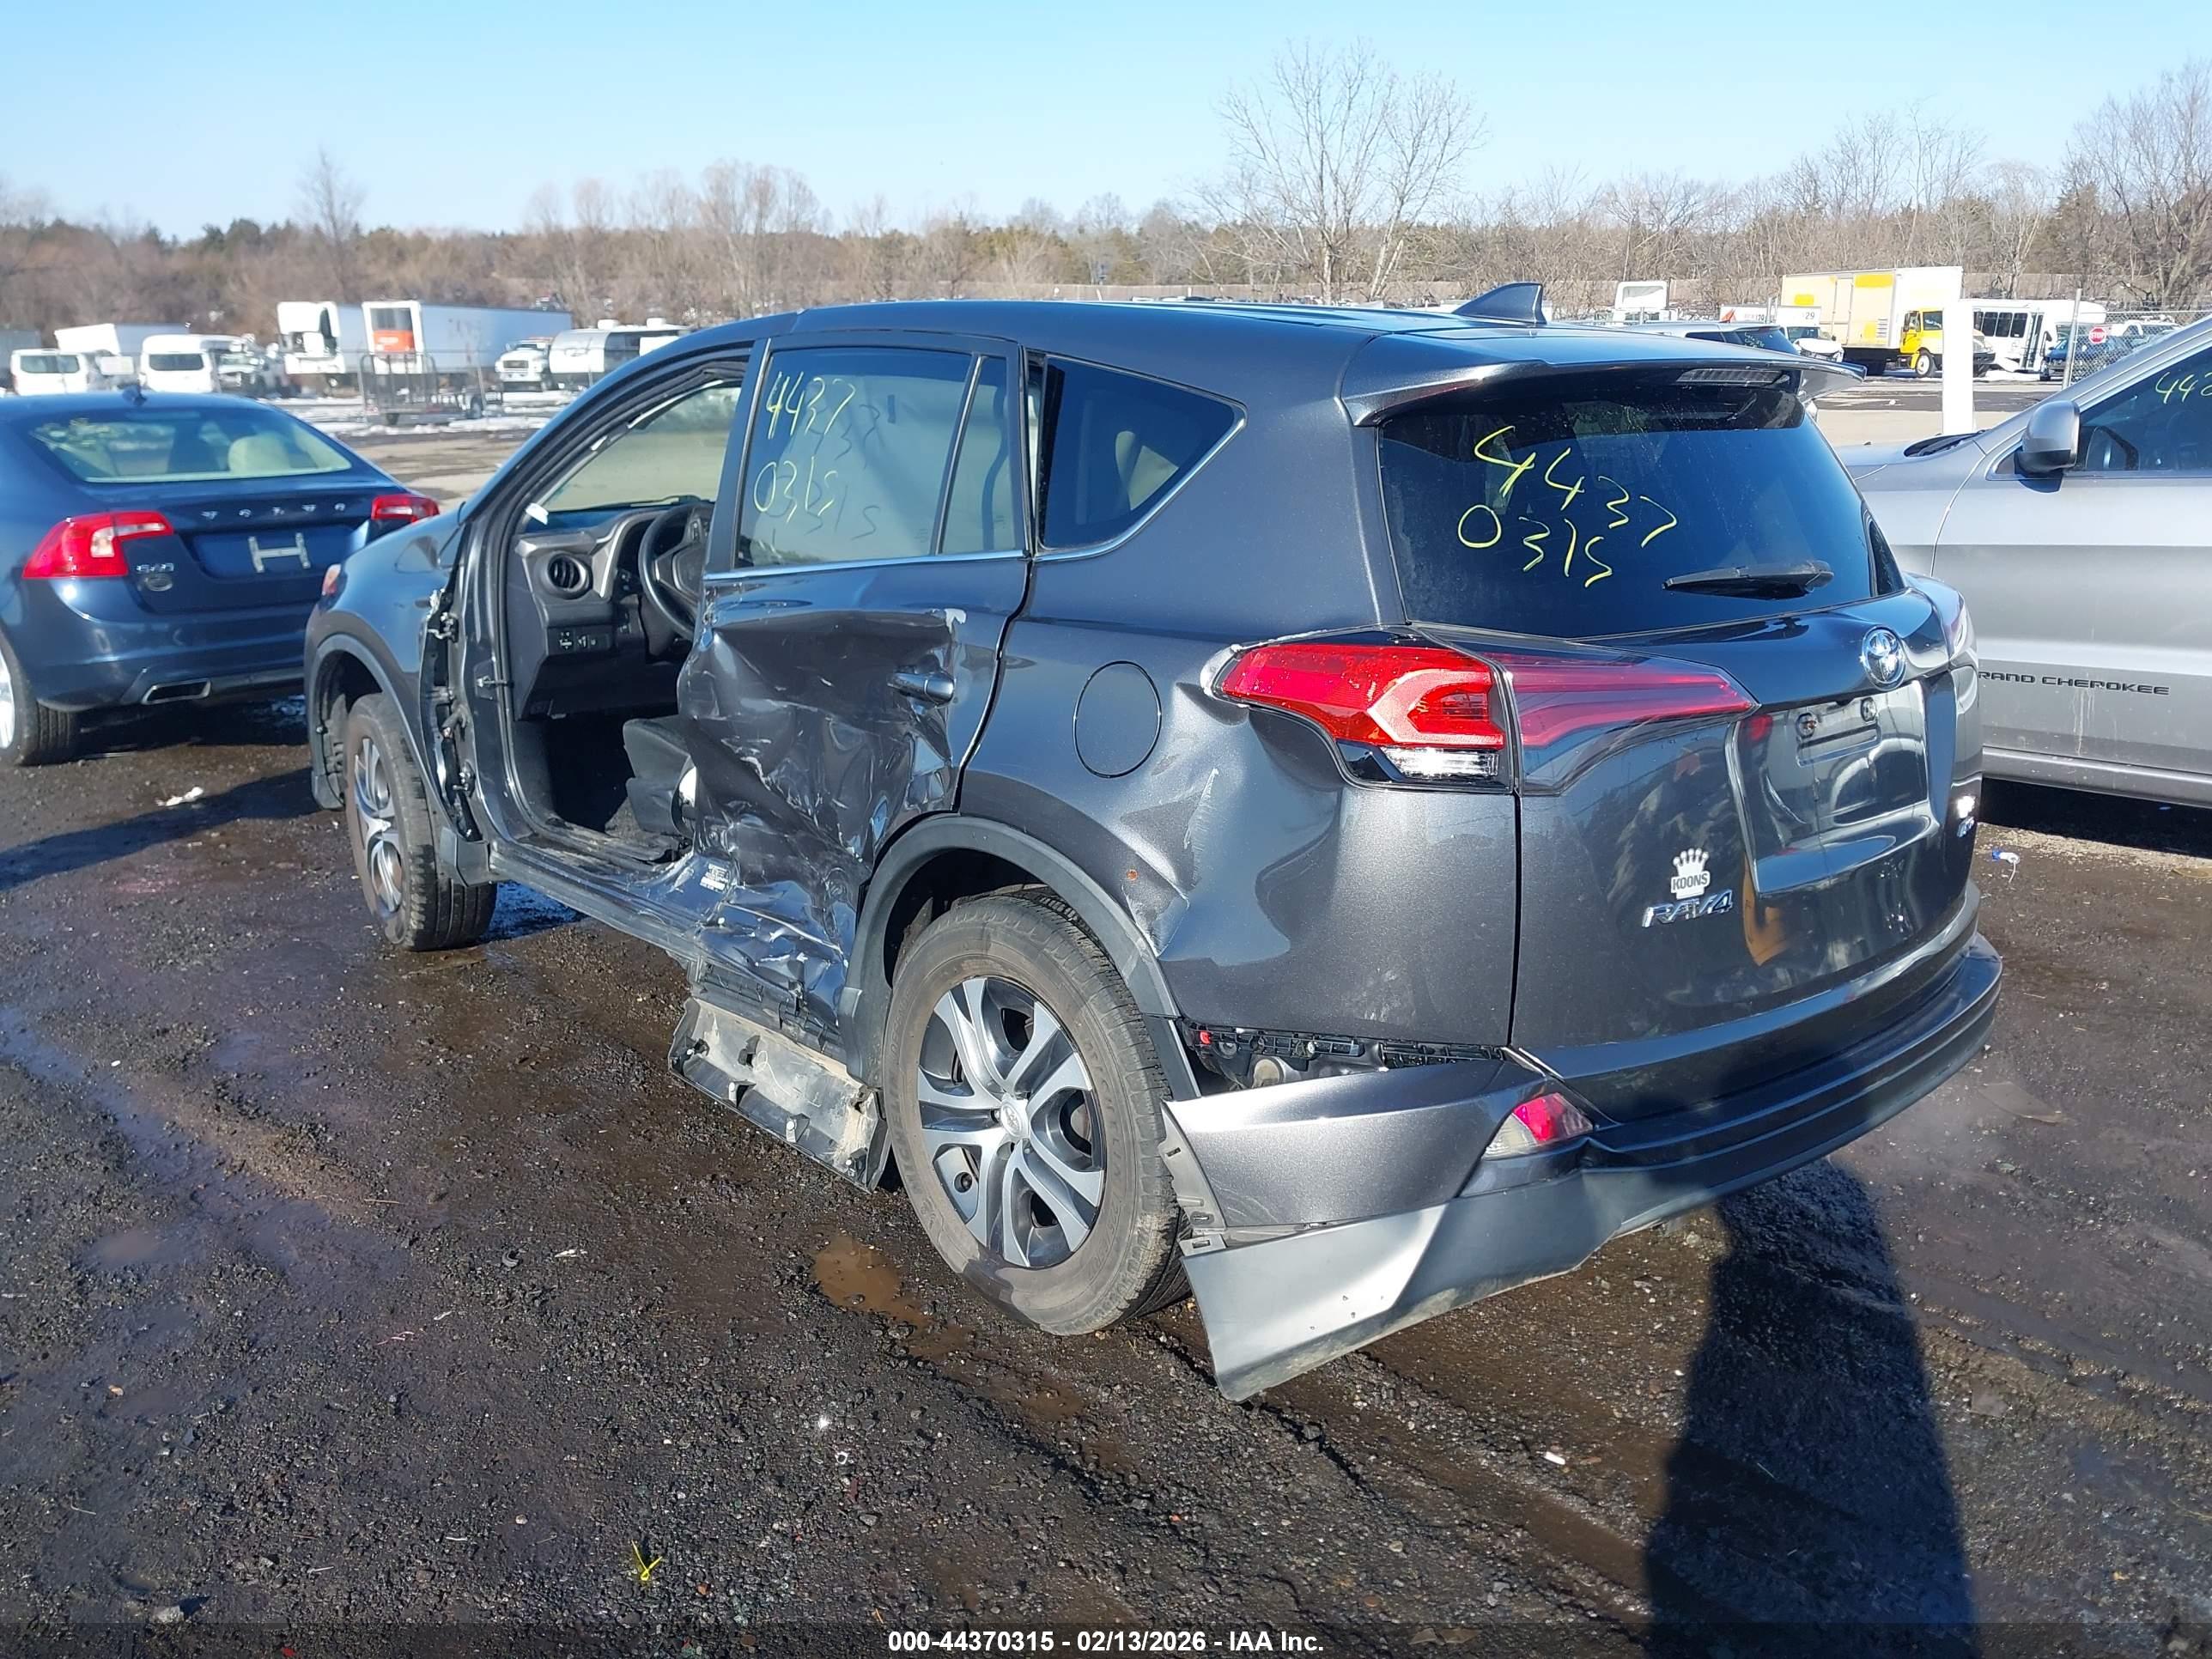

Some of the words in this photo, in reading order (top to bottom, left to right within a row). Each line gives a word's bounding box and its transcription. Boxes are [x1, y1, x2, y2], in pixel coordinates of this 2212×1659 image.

[1474, 425, 1678, 548] 4437
[1457, 503, 1613, 588] 0315
[1978, 671, 2035, 684] RAND
[2041, 677, 2170, 696] CHEROKEE
[1672, 872, 1708, 891] KOONS
[1642, 889, 1733, 927] RAV4
